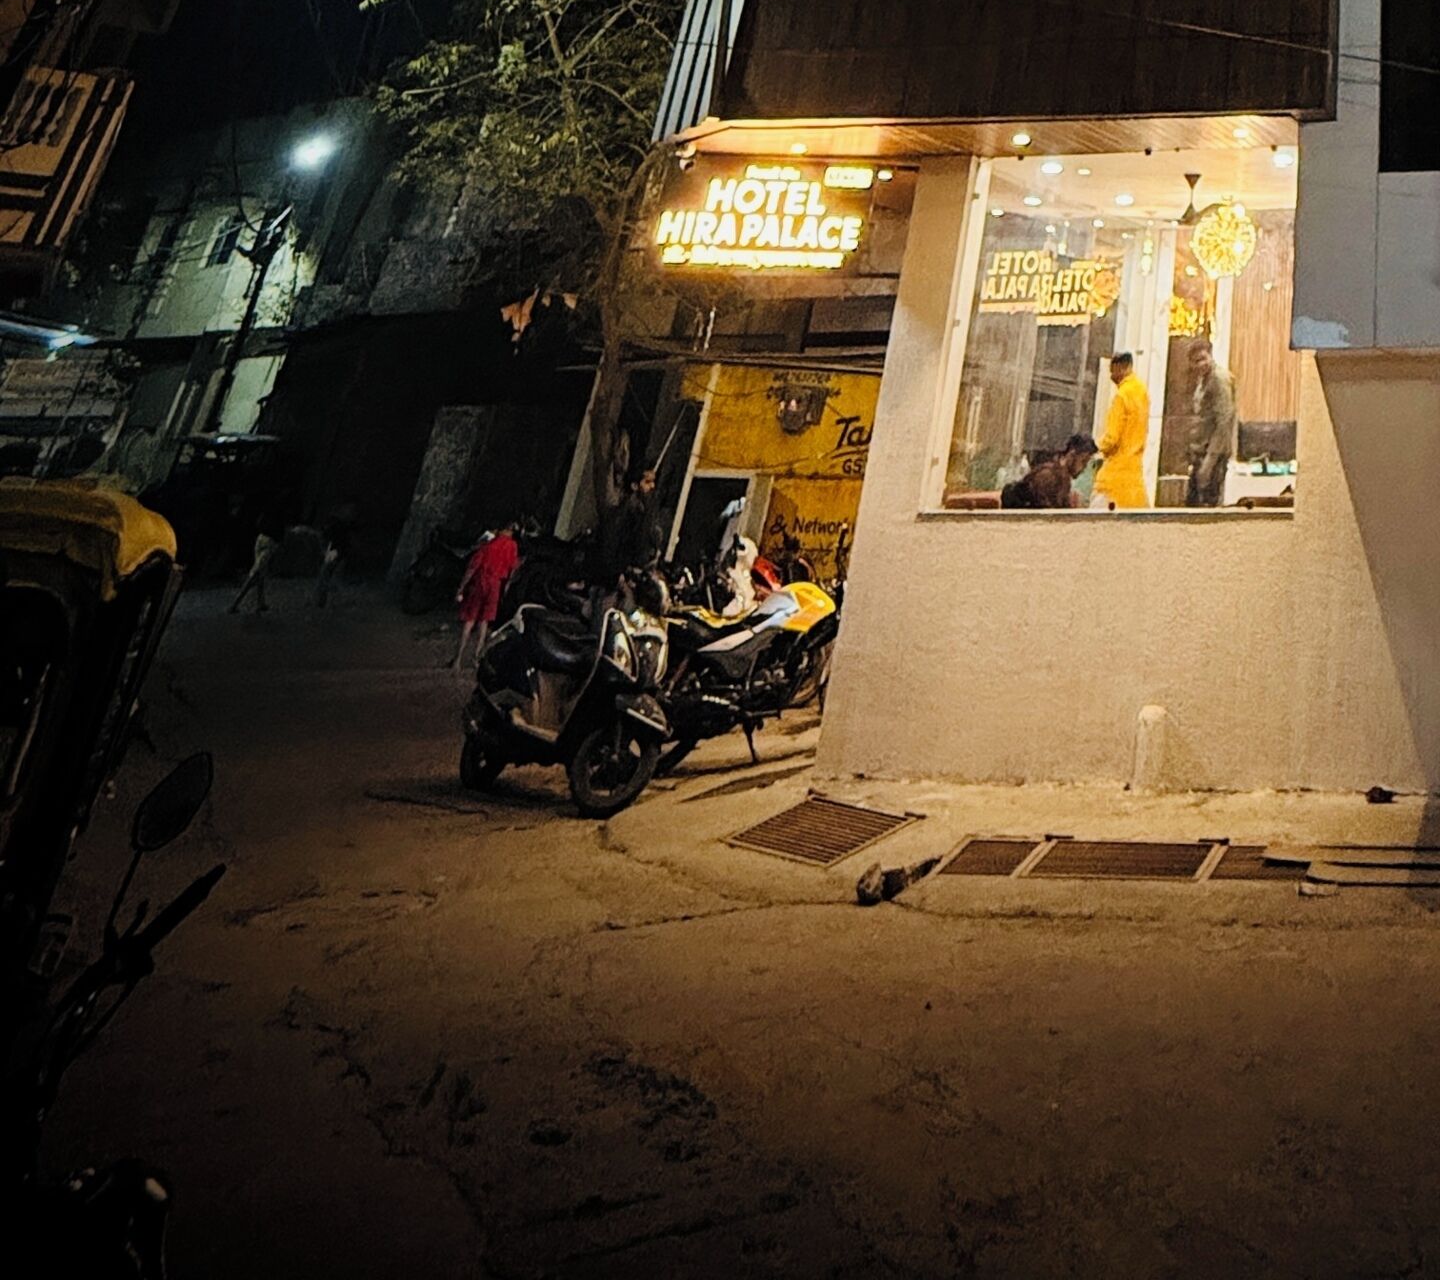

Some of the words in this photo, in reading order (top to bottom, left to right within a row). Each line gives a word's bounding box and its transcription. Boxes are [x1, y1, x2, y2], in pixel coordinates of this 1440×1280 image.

[705, 177, 827, 216] HOTEL
[656, 210, 736, 246] HIRA
[739, 212, 864, 251] PALACE
[842, 457, 868, 474] GS
